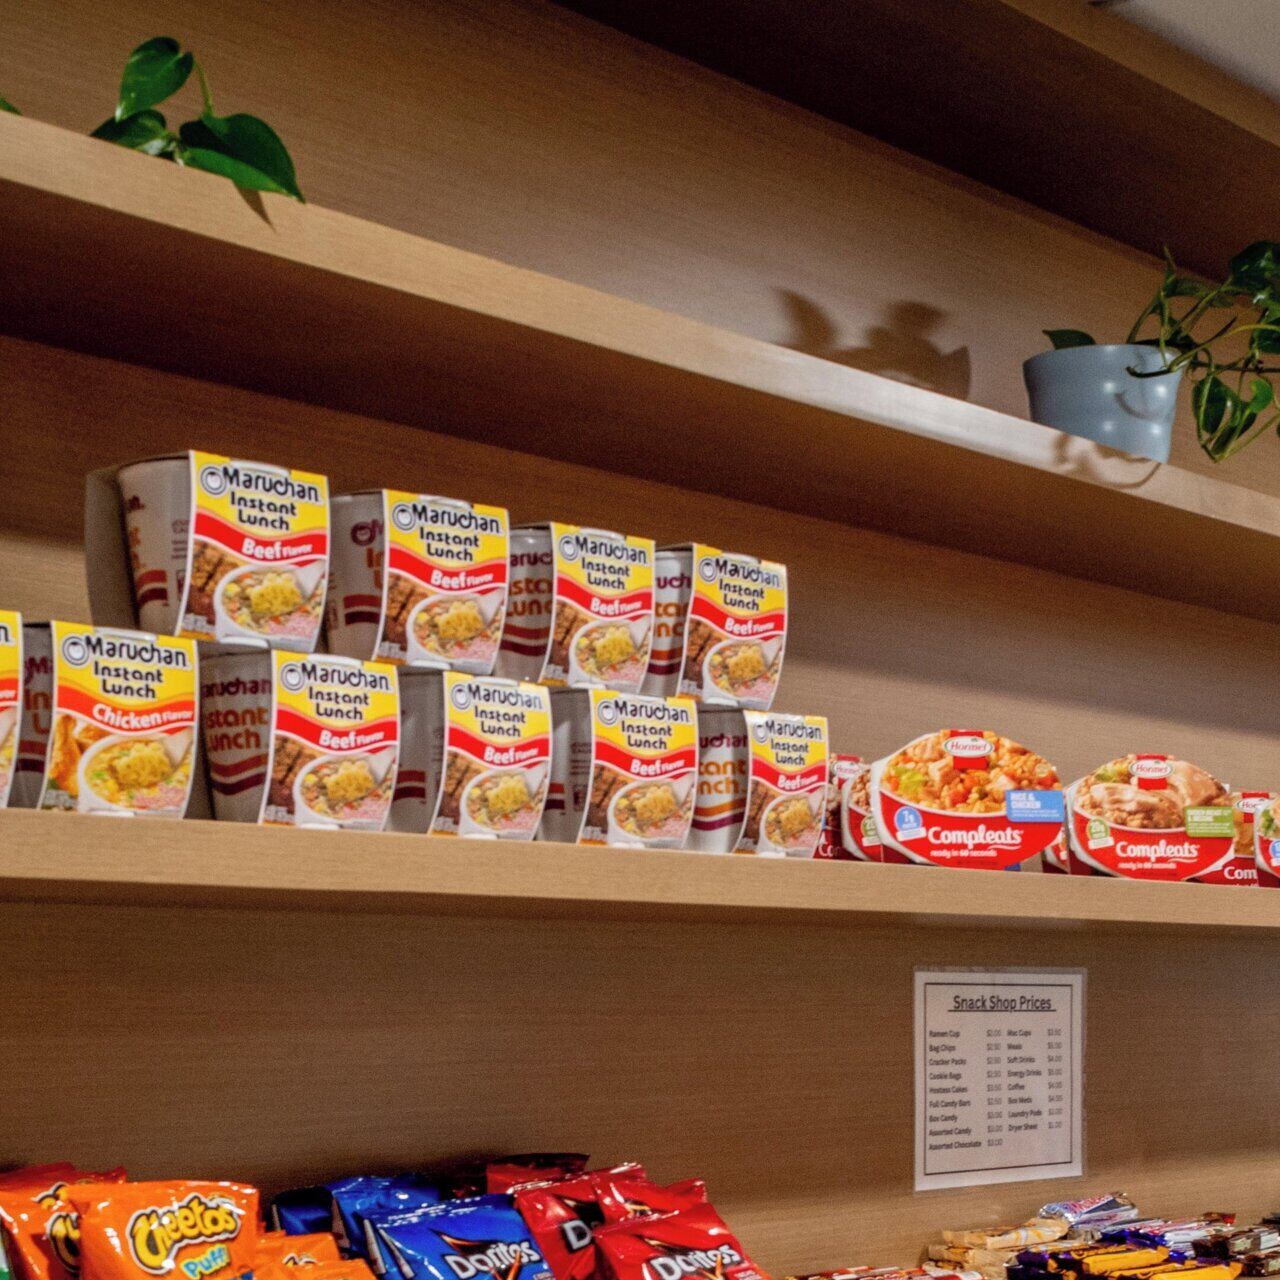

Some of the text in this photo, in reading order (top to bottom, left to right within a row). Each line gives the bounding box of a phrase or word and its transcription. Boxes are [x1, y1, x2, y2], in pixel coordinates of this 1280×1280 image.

[223, 467, 318, 501] Maruchan
[231, 492, 297, 516] Instant
[238, 509, 289, 530] Lunch
[412, 503, 500, 533] Maruchan
[420, 527, 479, 547] Instant
[242, 538, 282, 559] Beef
[427, 544, 473, 561] Lunch
[575, 535, 647, 564] Maruchan
[582, 557, 630, 577] Instant
[715, 558, 780, 585] Maruchan
[431, 570, 466, 588] Beef
[587, 572, 625, 590] Lunch
[719, 579, 764, 599] Instant
[591, 598, 620, 616] Beef
[723, 594, 759, 611] Lunch
[725, 618, 752, 634] Beef
[85, 636, 186, 666] Maruchan
[94, 661, 163, 682] Instant
[301, 663, 389, 690] Maruchan
[102, 679, 156, 698] Lunch
[309, 687, 369, 705] Instant
[468, 683, 542, 709] Maruchan
[93, 703, 162, 729] Chicken
[316, 705, 363, 720] Lunch
[475, 706, 526, 723] Instant
[615, 701, 689, 722] Maruchan
[481, 722, 520, 737] Lunch
[622, 721, 672, 736] Instant
[766, 720, 822, 739] Maruchan
[320, 730, 356, 748] Beef
[628, 736, 666, 749] Lunch
[771, 740, 809, 753] Instant
[951, 741, 987, 750] Hormel
[484, 746, 515, 764] Beef
[775, 752, 805, 765] Lunch
[631, 759, 661, 776] Beef
[777, 775, 801, 789] Beef
[928, 824, 1022, 849] Compleats
[930, 850, 951, 858] ready
[1116, 840, 1198, 861] Compleats
[954, 995, 1051, 1012] Snack Shop Prices
[129, 1194, 238, 1270] Cheetos
[446, 1240, 543, 1280] Doritos
